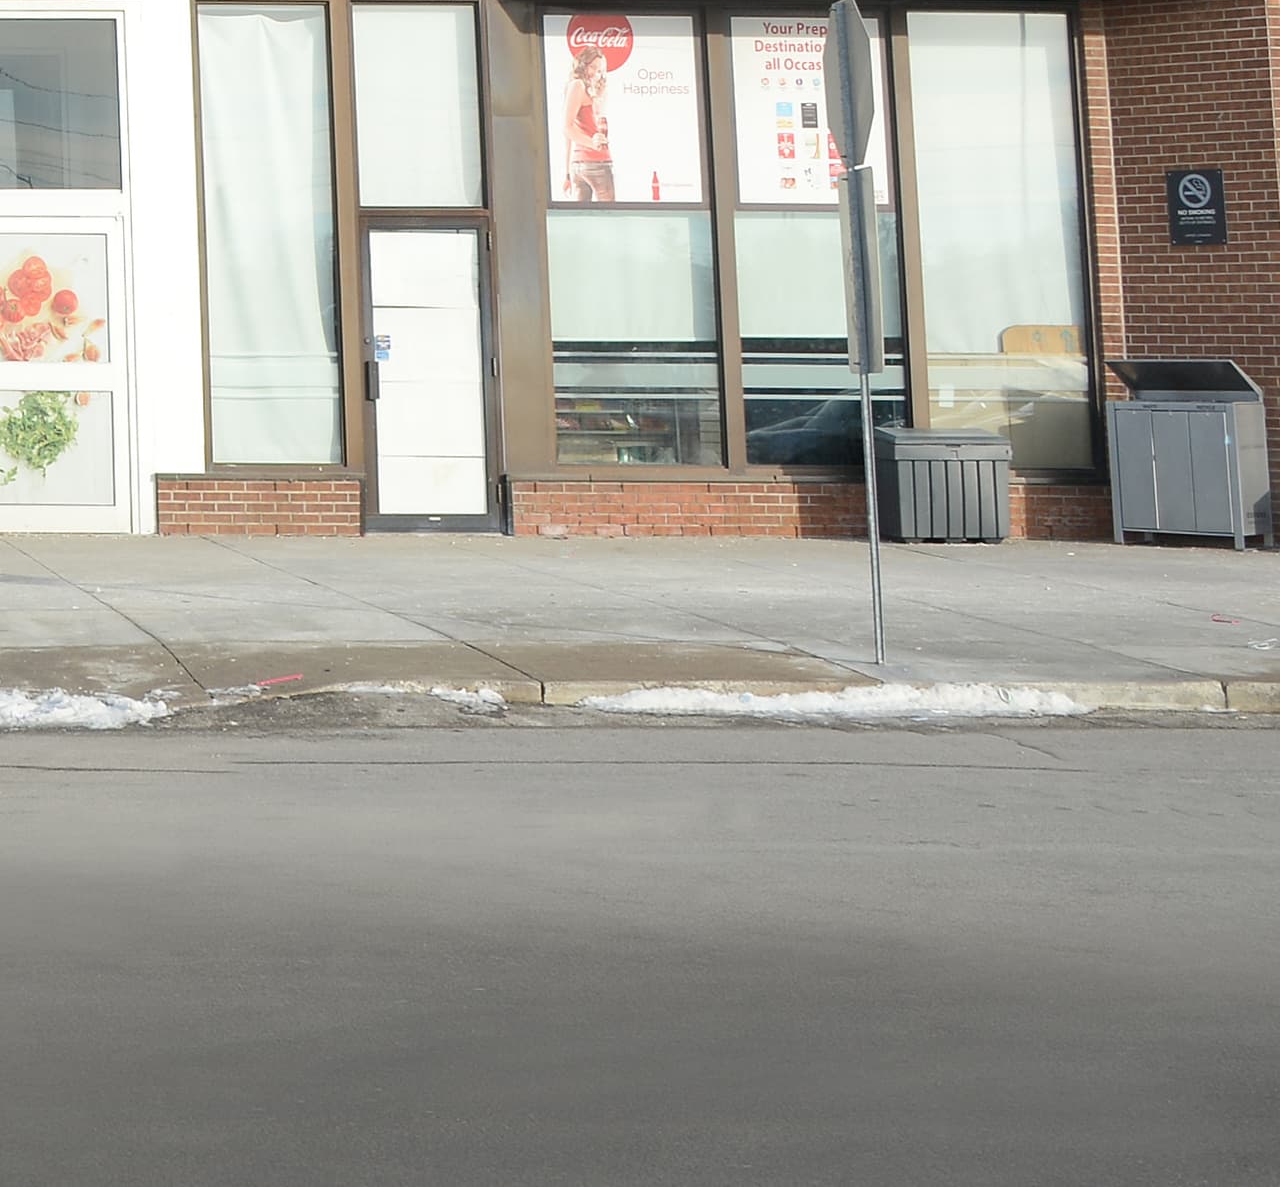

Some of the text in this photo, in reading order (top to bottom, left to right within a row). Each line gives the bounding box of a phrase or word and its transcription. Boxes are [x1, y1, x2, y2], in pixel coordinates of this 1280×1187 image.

[762, 21, 793, 35] Your
[570, 25, 630, 48] Coca-Cola
[754, 39, 826, 53] Destinatio
[765, 57, 781, 71] all
[637, 67, 674, 84] Open
[623, 83, 690, 99] Happiness
